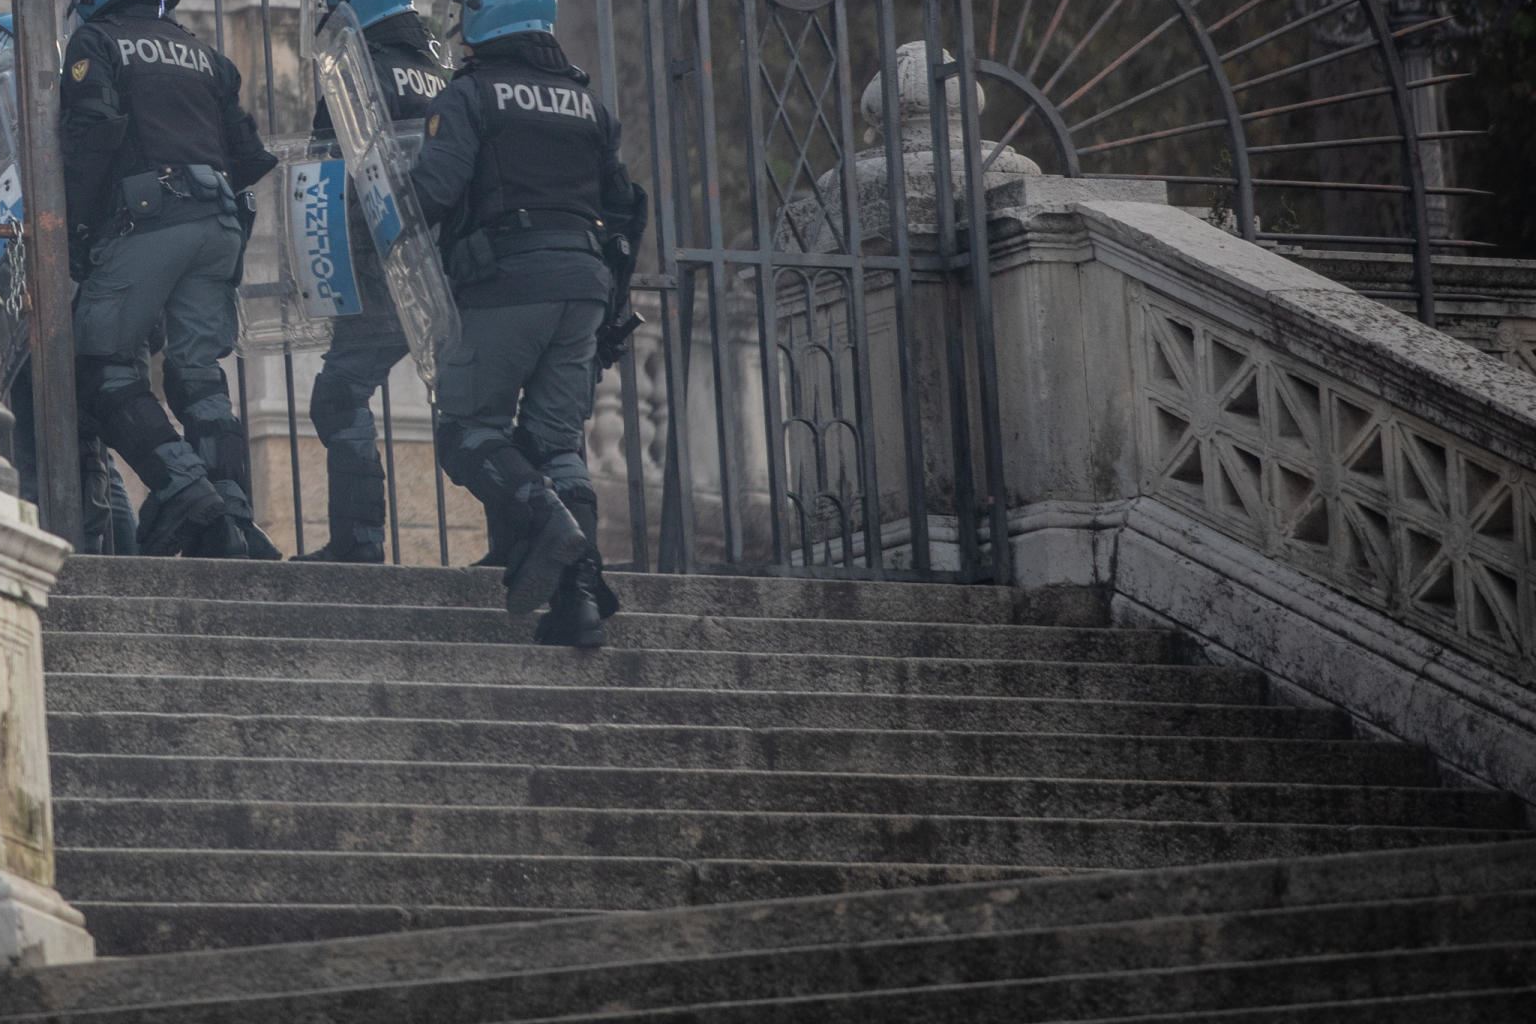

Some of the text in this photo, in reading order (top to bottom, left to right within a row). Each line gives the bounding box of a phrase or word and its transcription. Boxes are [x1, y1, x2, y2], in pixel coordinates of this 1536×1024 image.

[117, 38, 214, 76] POLIZIA
[493, 83, 597, 123] POLIZIA
[305, 177, 343, 300] POLIZIA
